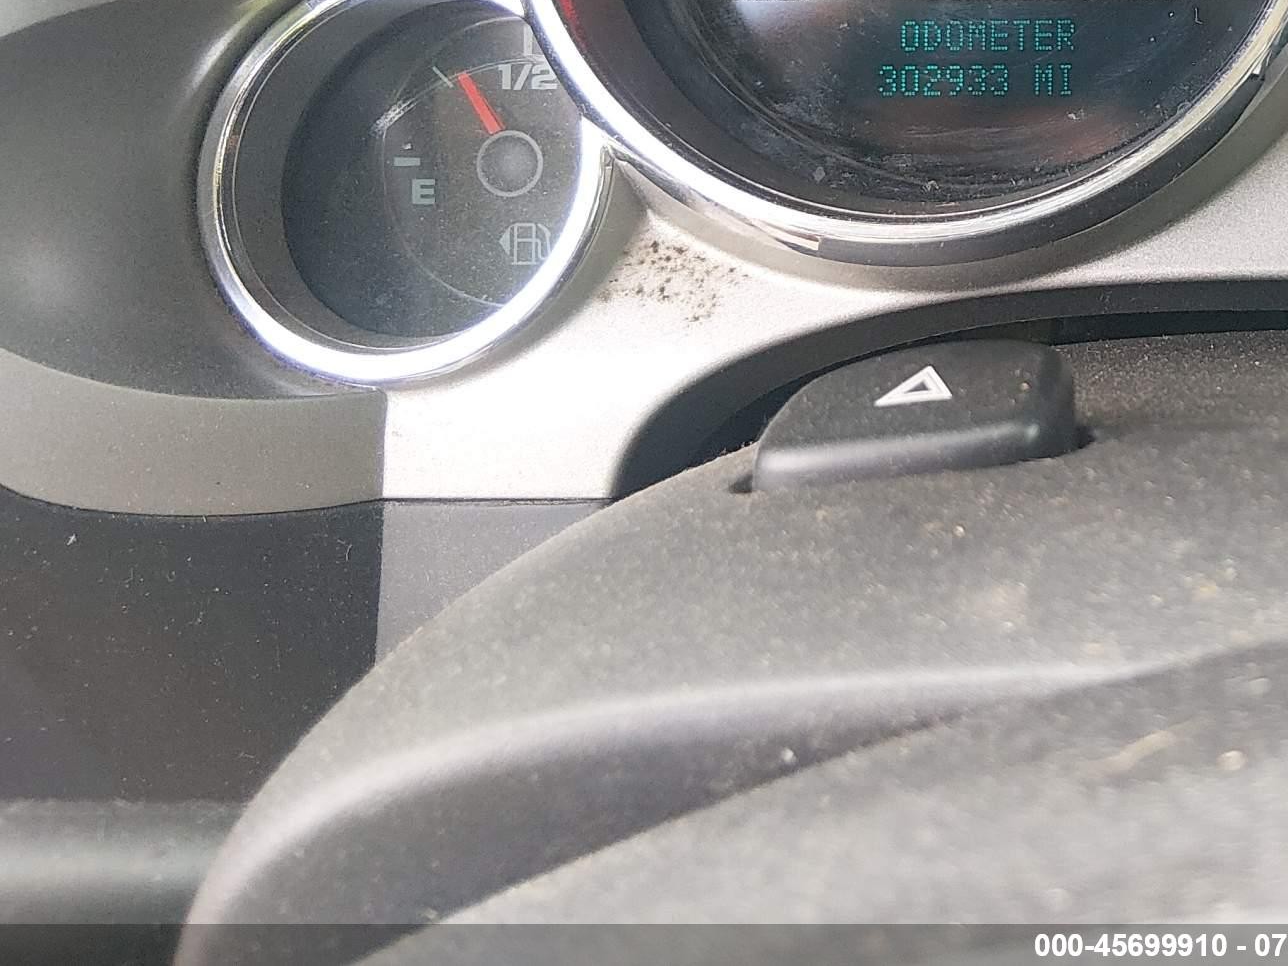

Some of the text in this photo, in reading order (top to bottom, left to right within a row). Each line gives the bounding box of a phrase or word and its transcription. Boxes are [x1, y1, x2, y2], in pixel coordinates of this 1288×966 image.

[902, 20, 1074, 51] ODOMETER
[498, 63, 558, 91] 1/2
[879, 65, 1073, 97] 302933 MI
[411, 177, 436, 205] E
